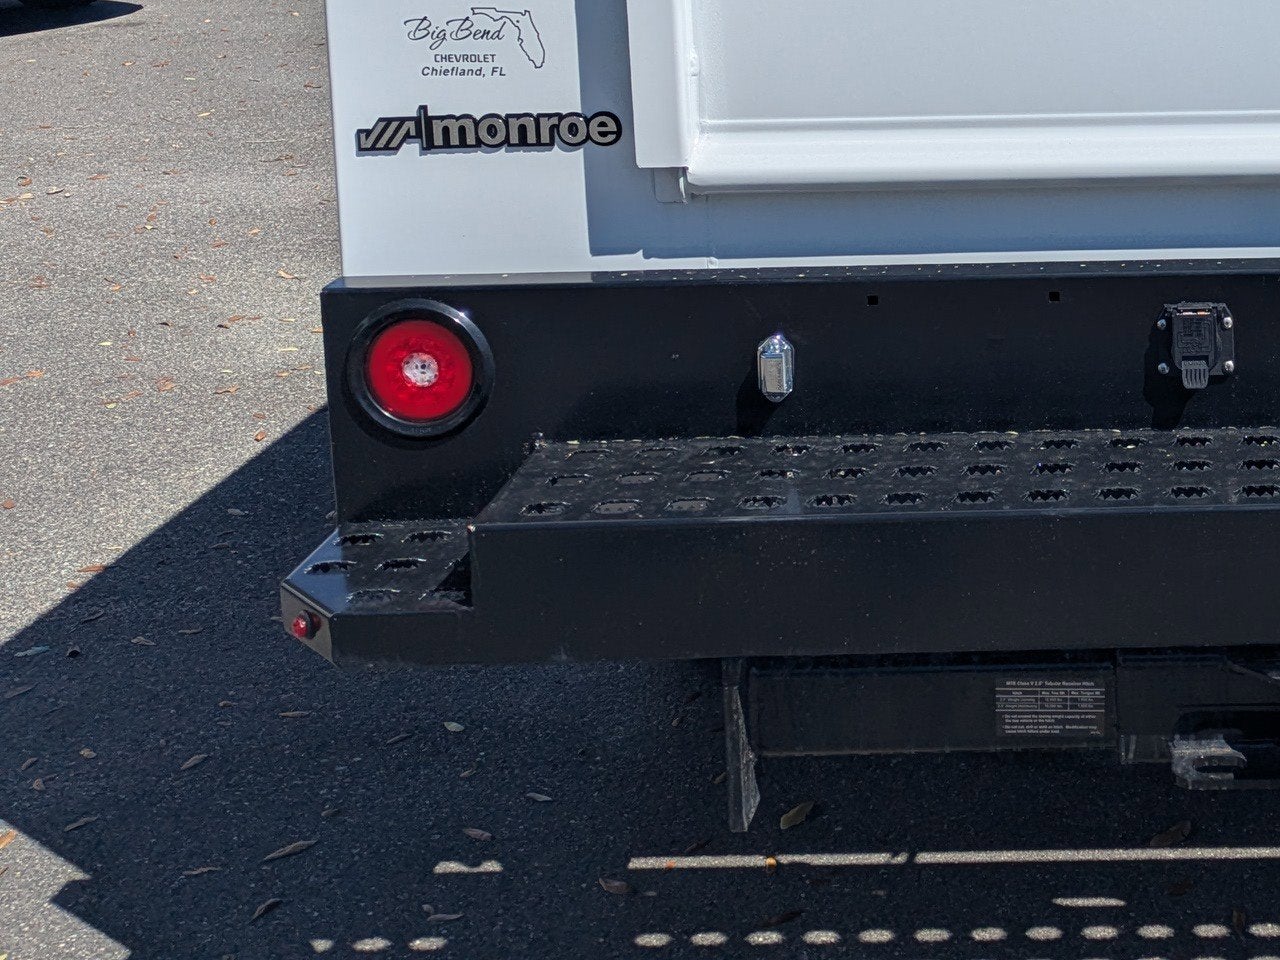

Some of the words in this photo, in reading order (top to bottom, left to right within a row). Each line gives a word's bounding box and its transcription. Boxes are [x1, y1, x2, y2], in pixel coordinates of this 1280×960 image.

[403, 16, 448, 50] Big
[445, 16, 506, 41] Bend
[434, 53, 496, 63] CHEVROLET
[421, 66, 486, 78] Chiefland,
[491, 67, 507, 77] FL
[430, 112, 621, 147] monroe
